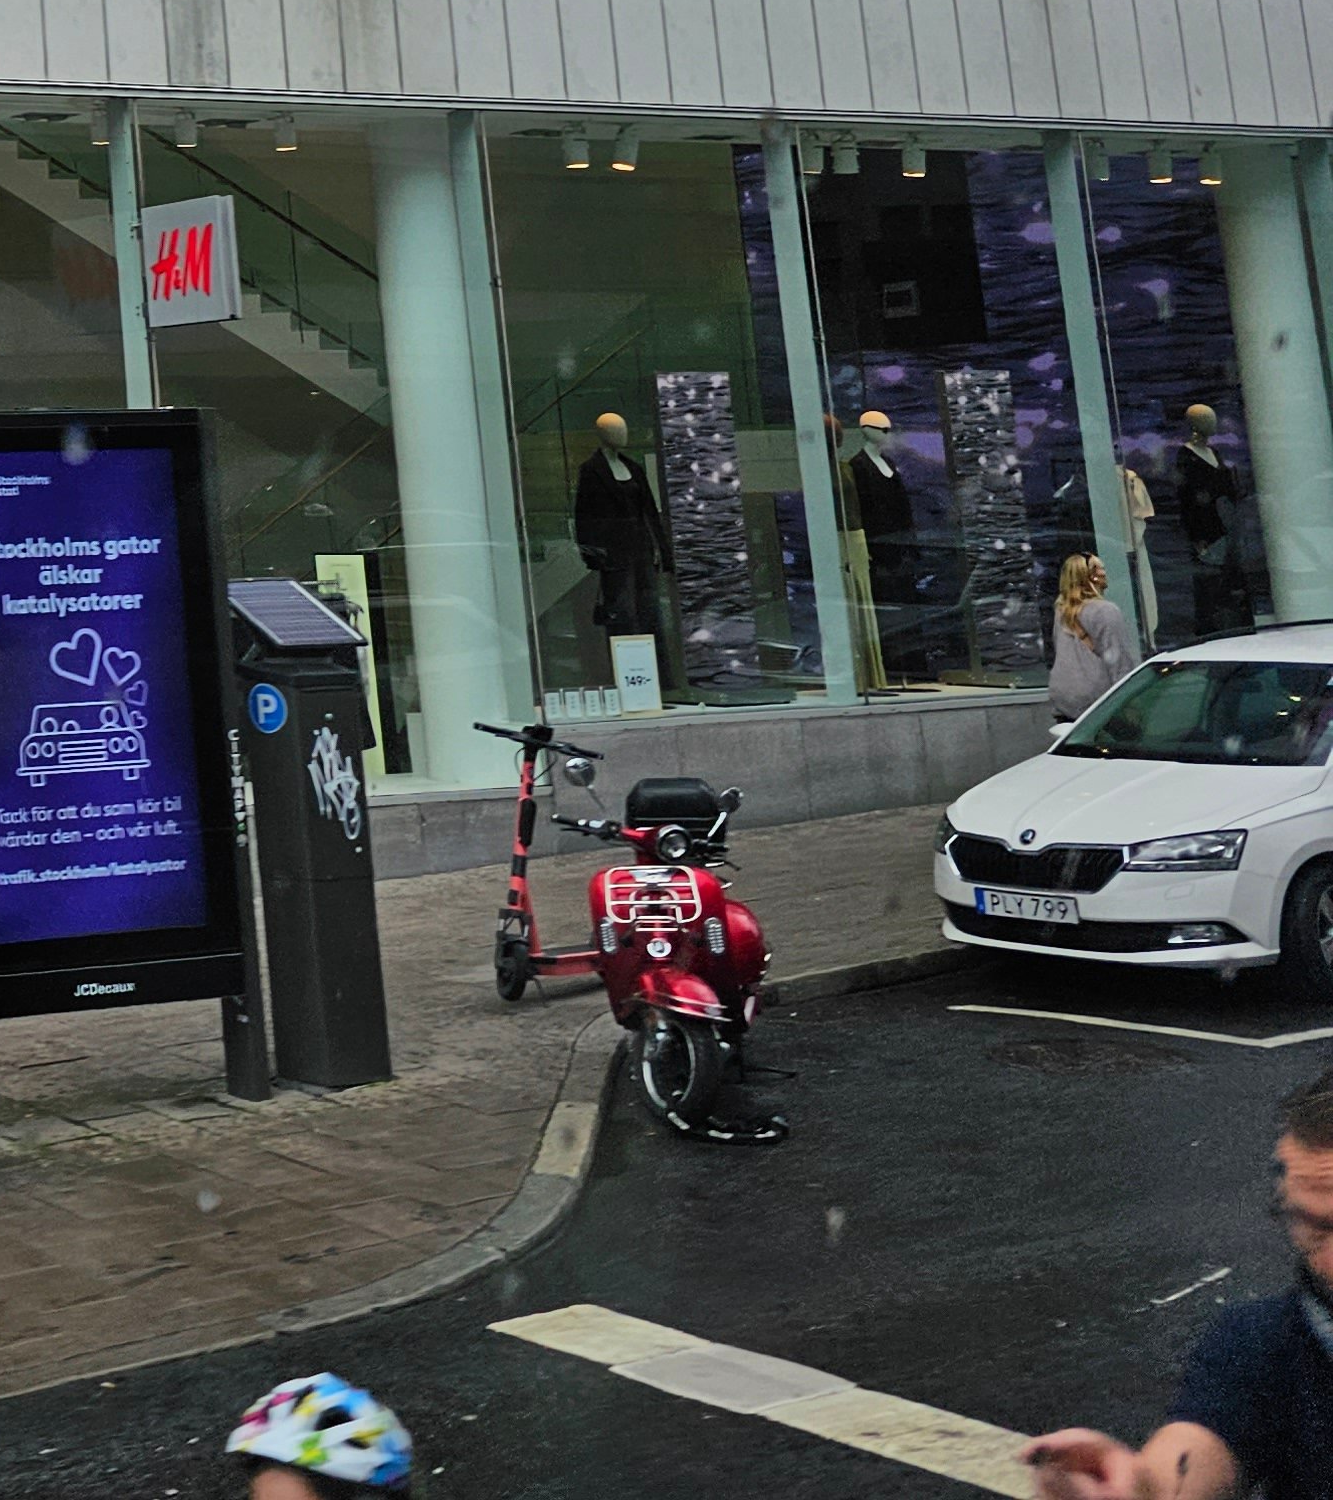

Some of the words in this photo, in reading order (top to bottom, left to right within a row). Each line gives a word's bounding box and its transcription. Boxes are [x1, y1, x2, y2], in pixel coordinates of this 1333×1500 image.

[150, 222, 215, 302] H&M
[103, 536, 162, 560] gator
[39, 564, 104, 585] älskar
[2, 592, 144, 617] katalysatorer
[30, 805, 53, 822] för
[56, 805, 78, 820] att
[80, 802, 102, 819] du
[102, 802, 136, 816] som
[136, 797, 162, 814] kör
[163, 796, 182, 812] bil
[50, 828, 82, 844] den
[95, 824, 126, 841] och
[990, 893, 1024, 914] PLY
[1030, 898, 1068, 920] 799
[73, 982, 136, 997] JCDecaux
